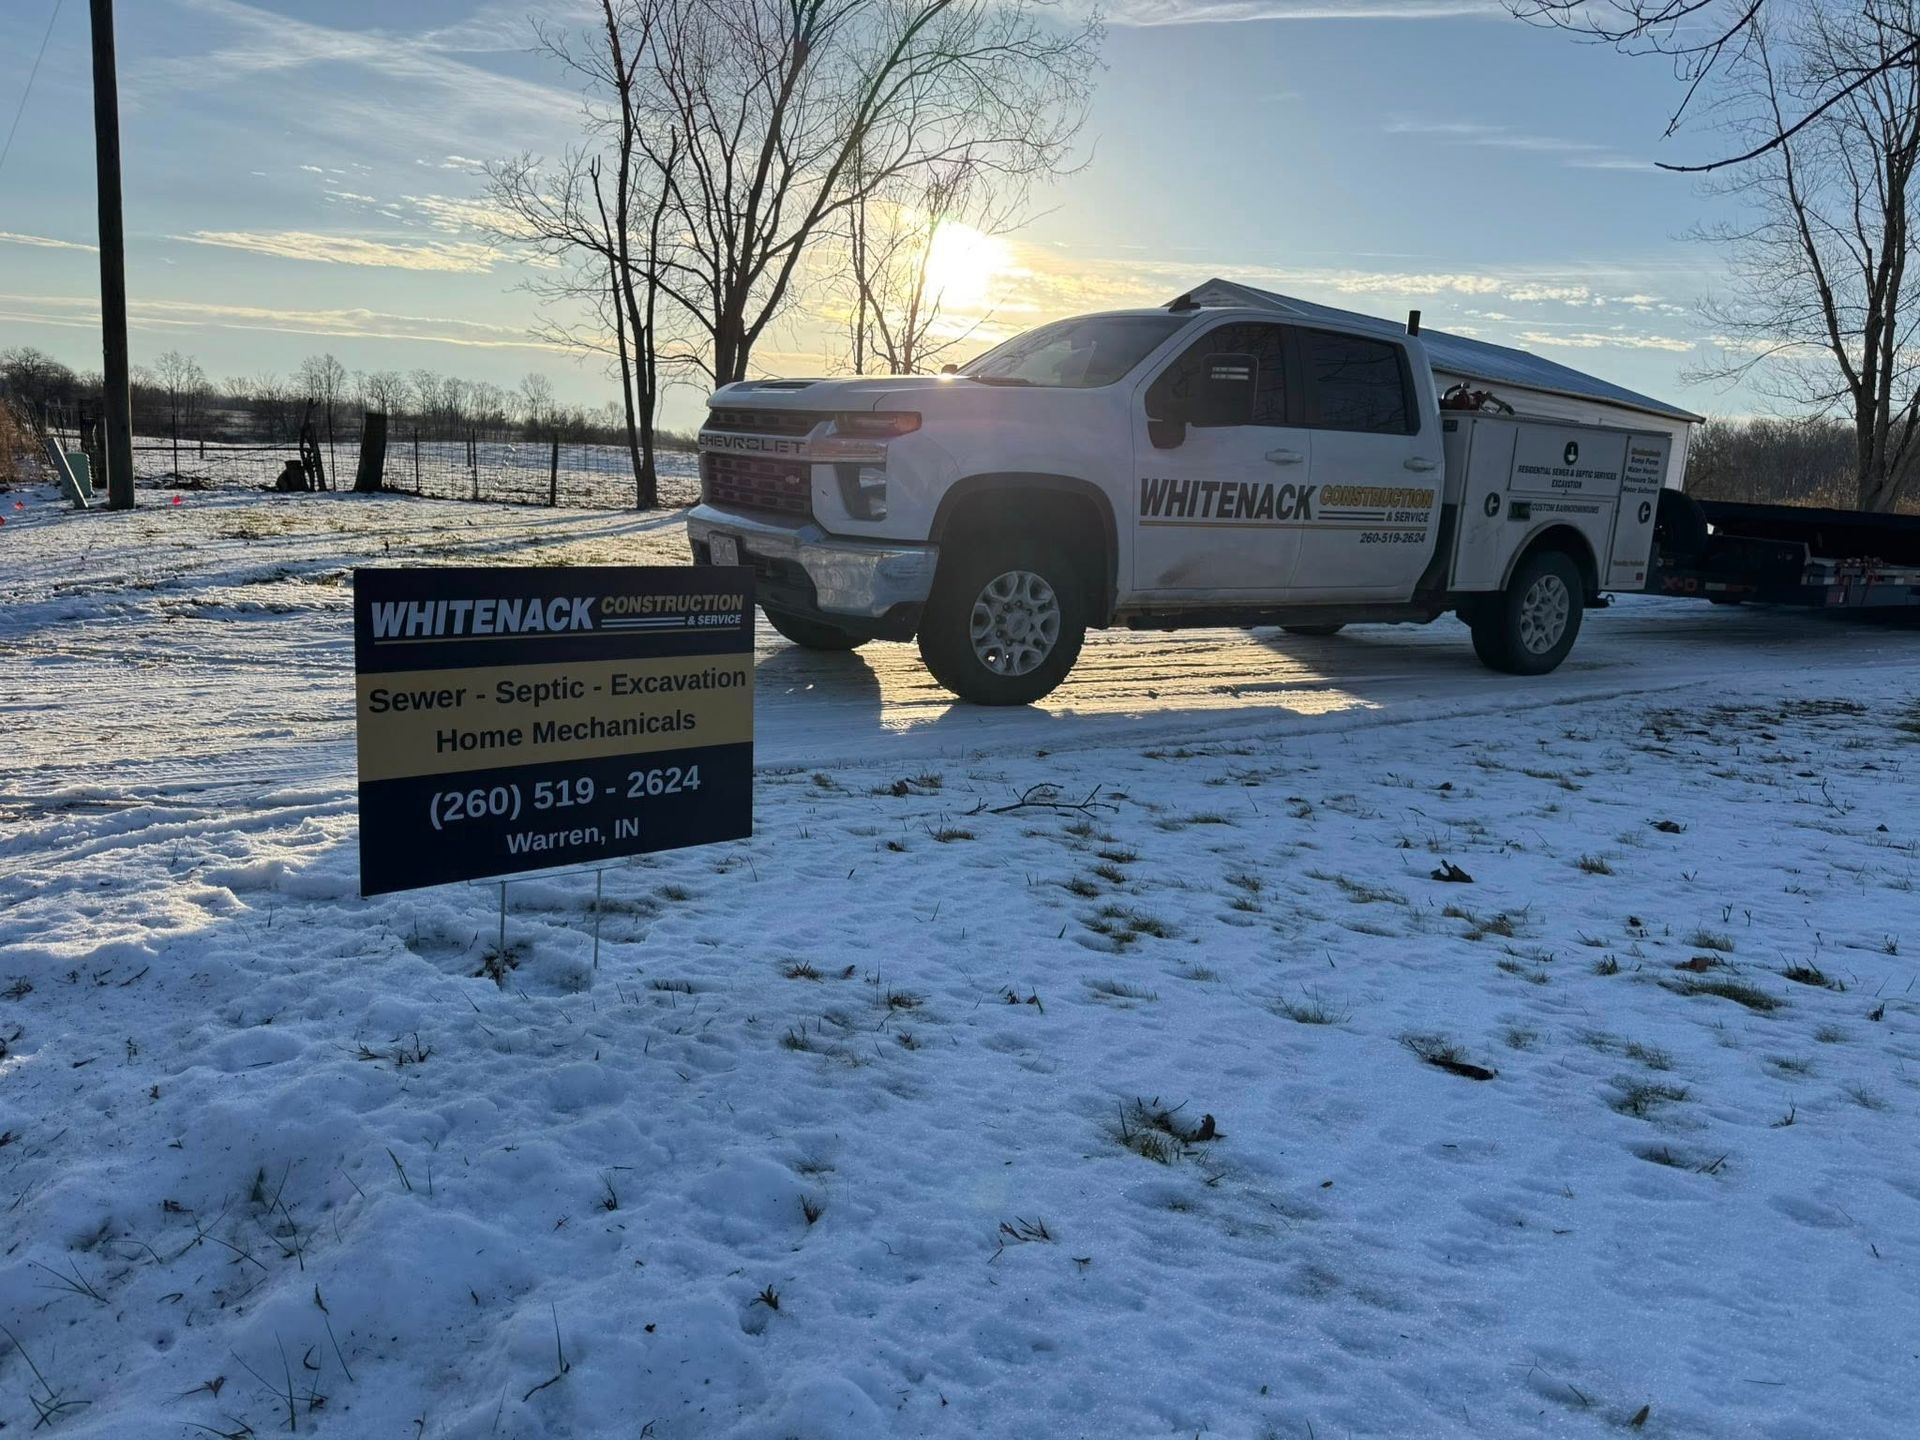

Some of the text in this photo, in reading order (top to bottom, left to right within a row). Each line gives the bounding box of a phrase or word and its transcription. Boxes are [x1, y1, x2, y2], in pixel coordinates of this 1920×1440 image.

[700, 434, 806, 454] CHEVROLET
[1517, 465, 1551, 475] RESIDENTIAL
[1552, 468, 1570, 476] SEWER
[1576, 470, 1593, 478] SEPTIC
[1594, 471, 1617, 480] SERVICES
[1552, 479, 1582, 489] EXCAVATION
[1140, 478, 1435, 520] WHITENACK CONSTRUCTION
[1532, 503, 1555, 512] CUSTOM
[1386, 511, 1430, 523] & SERVICE
[1360, 532, 1426, 544] 260-519-2624
[371, 594, 743, 638] WHITENACK CONSTRUCTION
[687, 614, 742, 626] & SERVICE
[368, 686, 467, 714] Sewer
[495, 676, 585, 708] Septic
[610, 667, 747, 696] Excavation
[436, 709, 696, 753] Home Mechanicals
[430, 784, 522, 830] (260)
[534, 776, 595, 810] 519
[627, 765, 701, 799] 2624
[506, 817, 639, 854] Warren, IN
